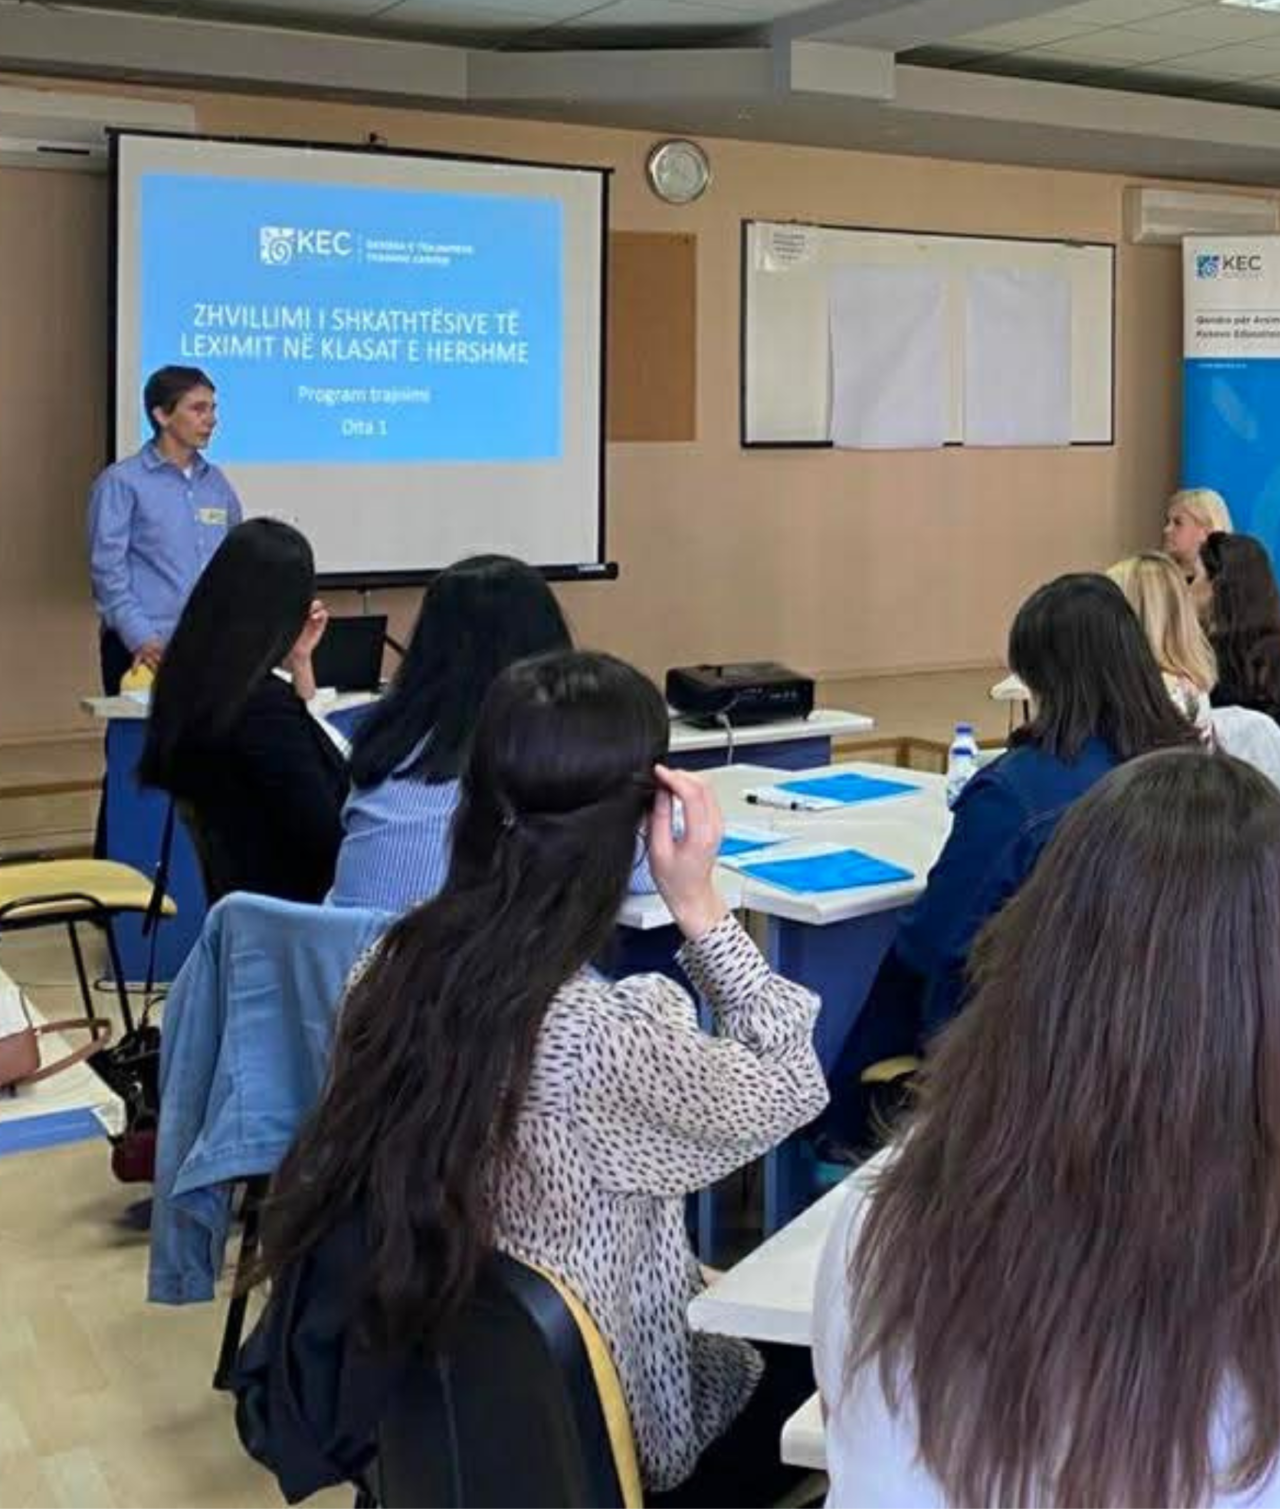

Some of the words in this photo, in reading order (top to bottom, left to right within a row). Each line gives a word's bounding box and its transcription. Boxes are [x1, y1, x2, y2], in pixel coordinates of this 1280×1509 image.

[297, 229, 352, 256] KEC
[1223, 255, 1262, 271] KEC
[194, 303, 310, 330] ZHVILLIMI
[317, 308, 324, 330] I
[332, 304, 489, 335] SHKATHTËSIVE
[495, 309, 520, 336] TË
[180, 333, 279, 359] LEXIMIT
[283, 333, 315, 360] NË
[321, 337, 399, 362] KLASAT
[408, 339, 420, 363] E
[427, 341, 529, 365] HERSHME
[299, 385, 367, 408] Program
